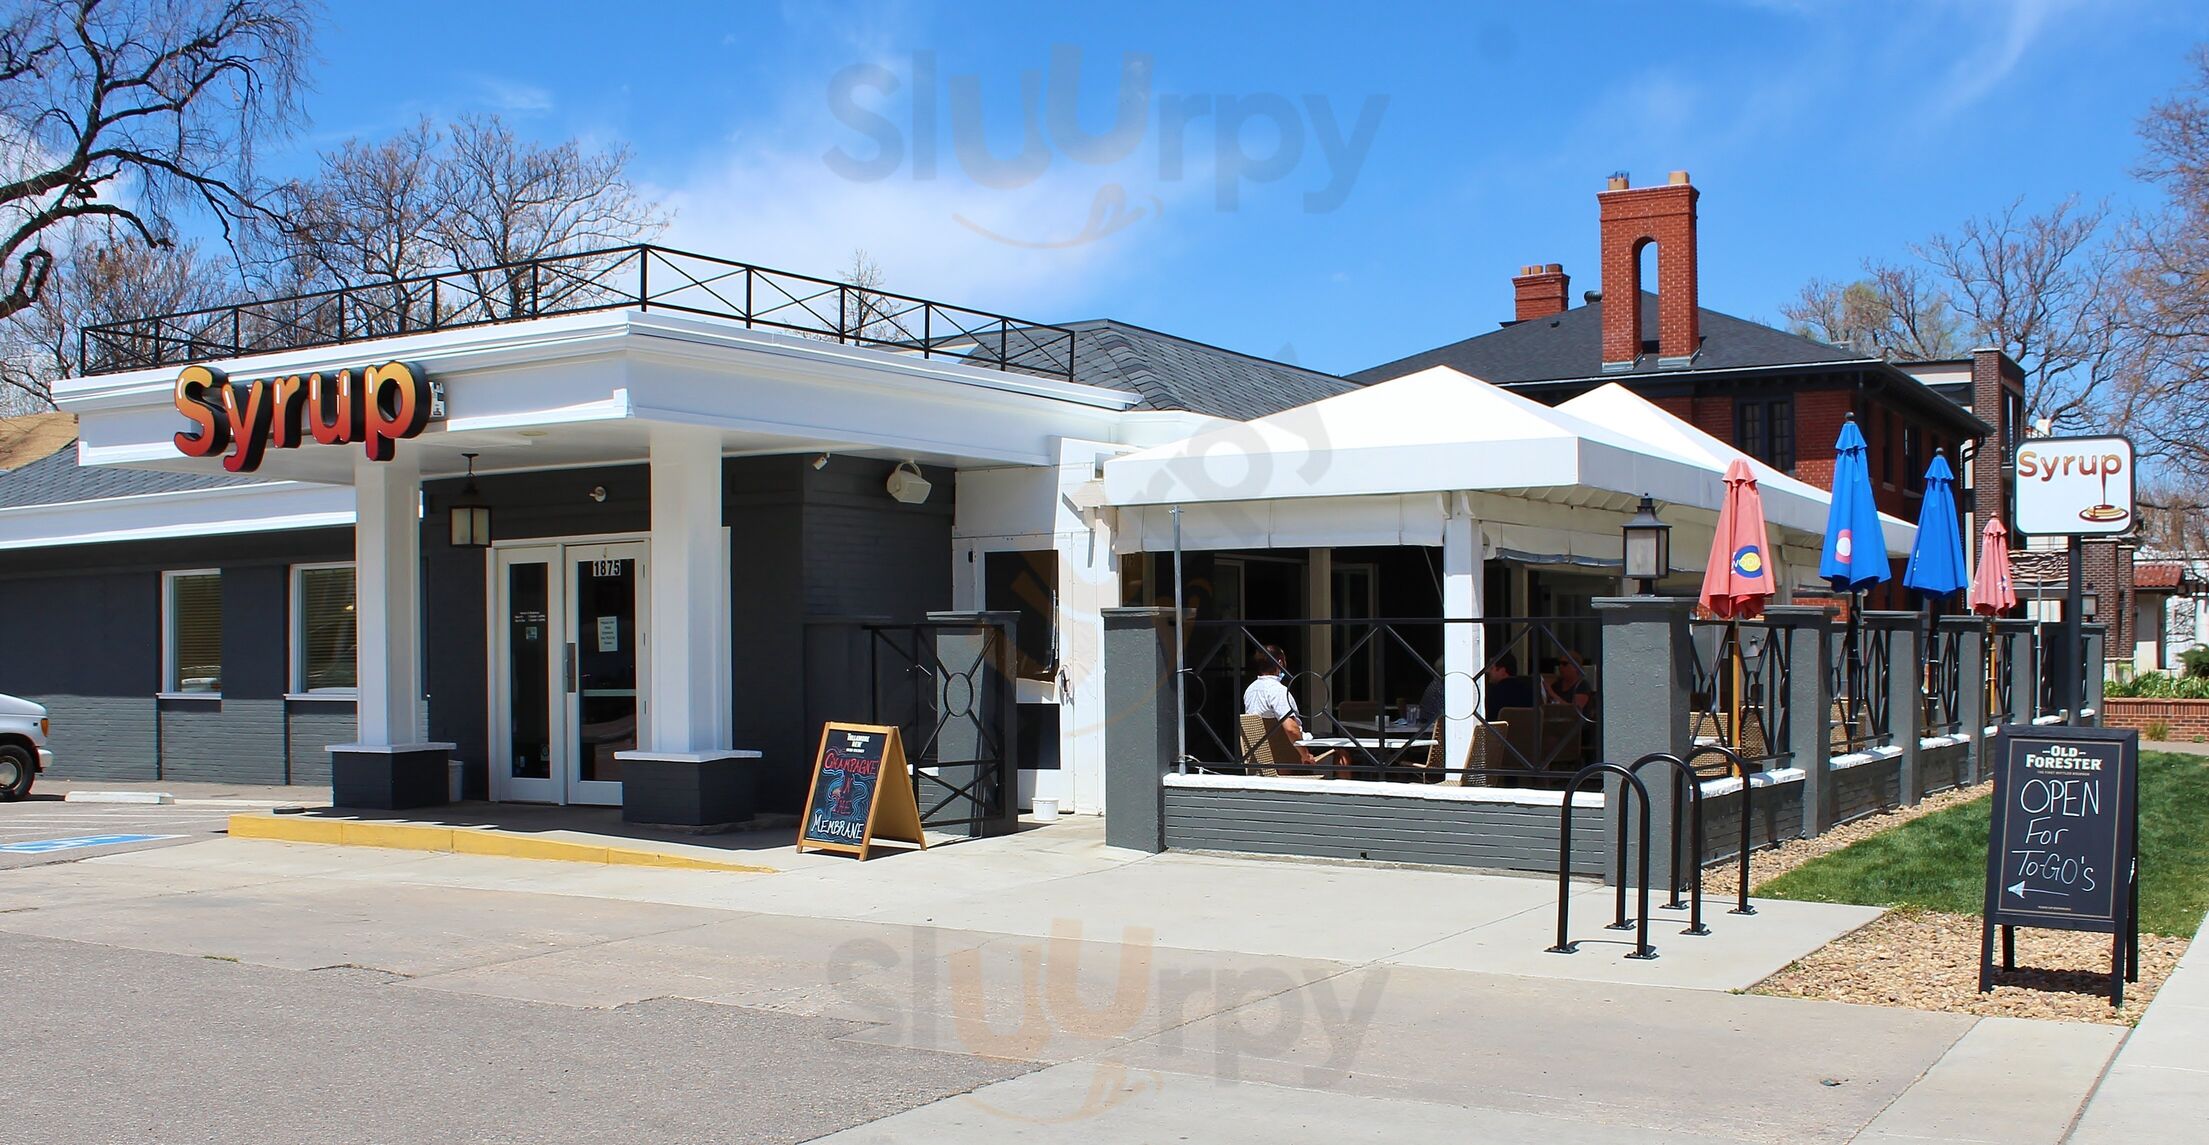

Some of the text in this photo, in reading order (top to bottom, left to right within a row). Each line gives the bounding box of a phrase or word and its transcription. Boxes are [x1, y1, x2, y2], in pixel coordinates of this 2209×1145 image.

[173, 360, 431, 473] Syrup
[2017, 451, 2122, 483] Syrup
[594, 559, 620, 576] 1875
[2025, 754, 2102, 770] FORESTER
[2050, 745, 2078, 757] OLD
[2020, 779, 2099, 817] OPEN
[811, 814, 864, 839] MEMBRANE
